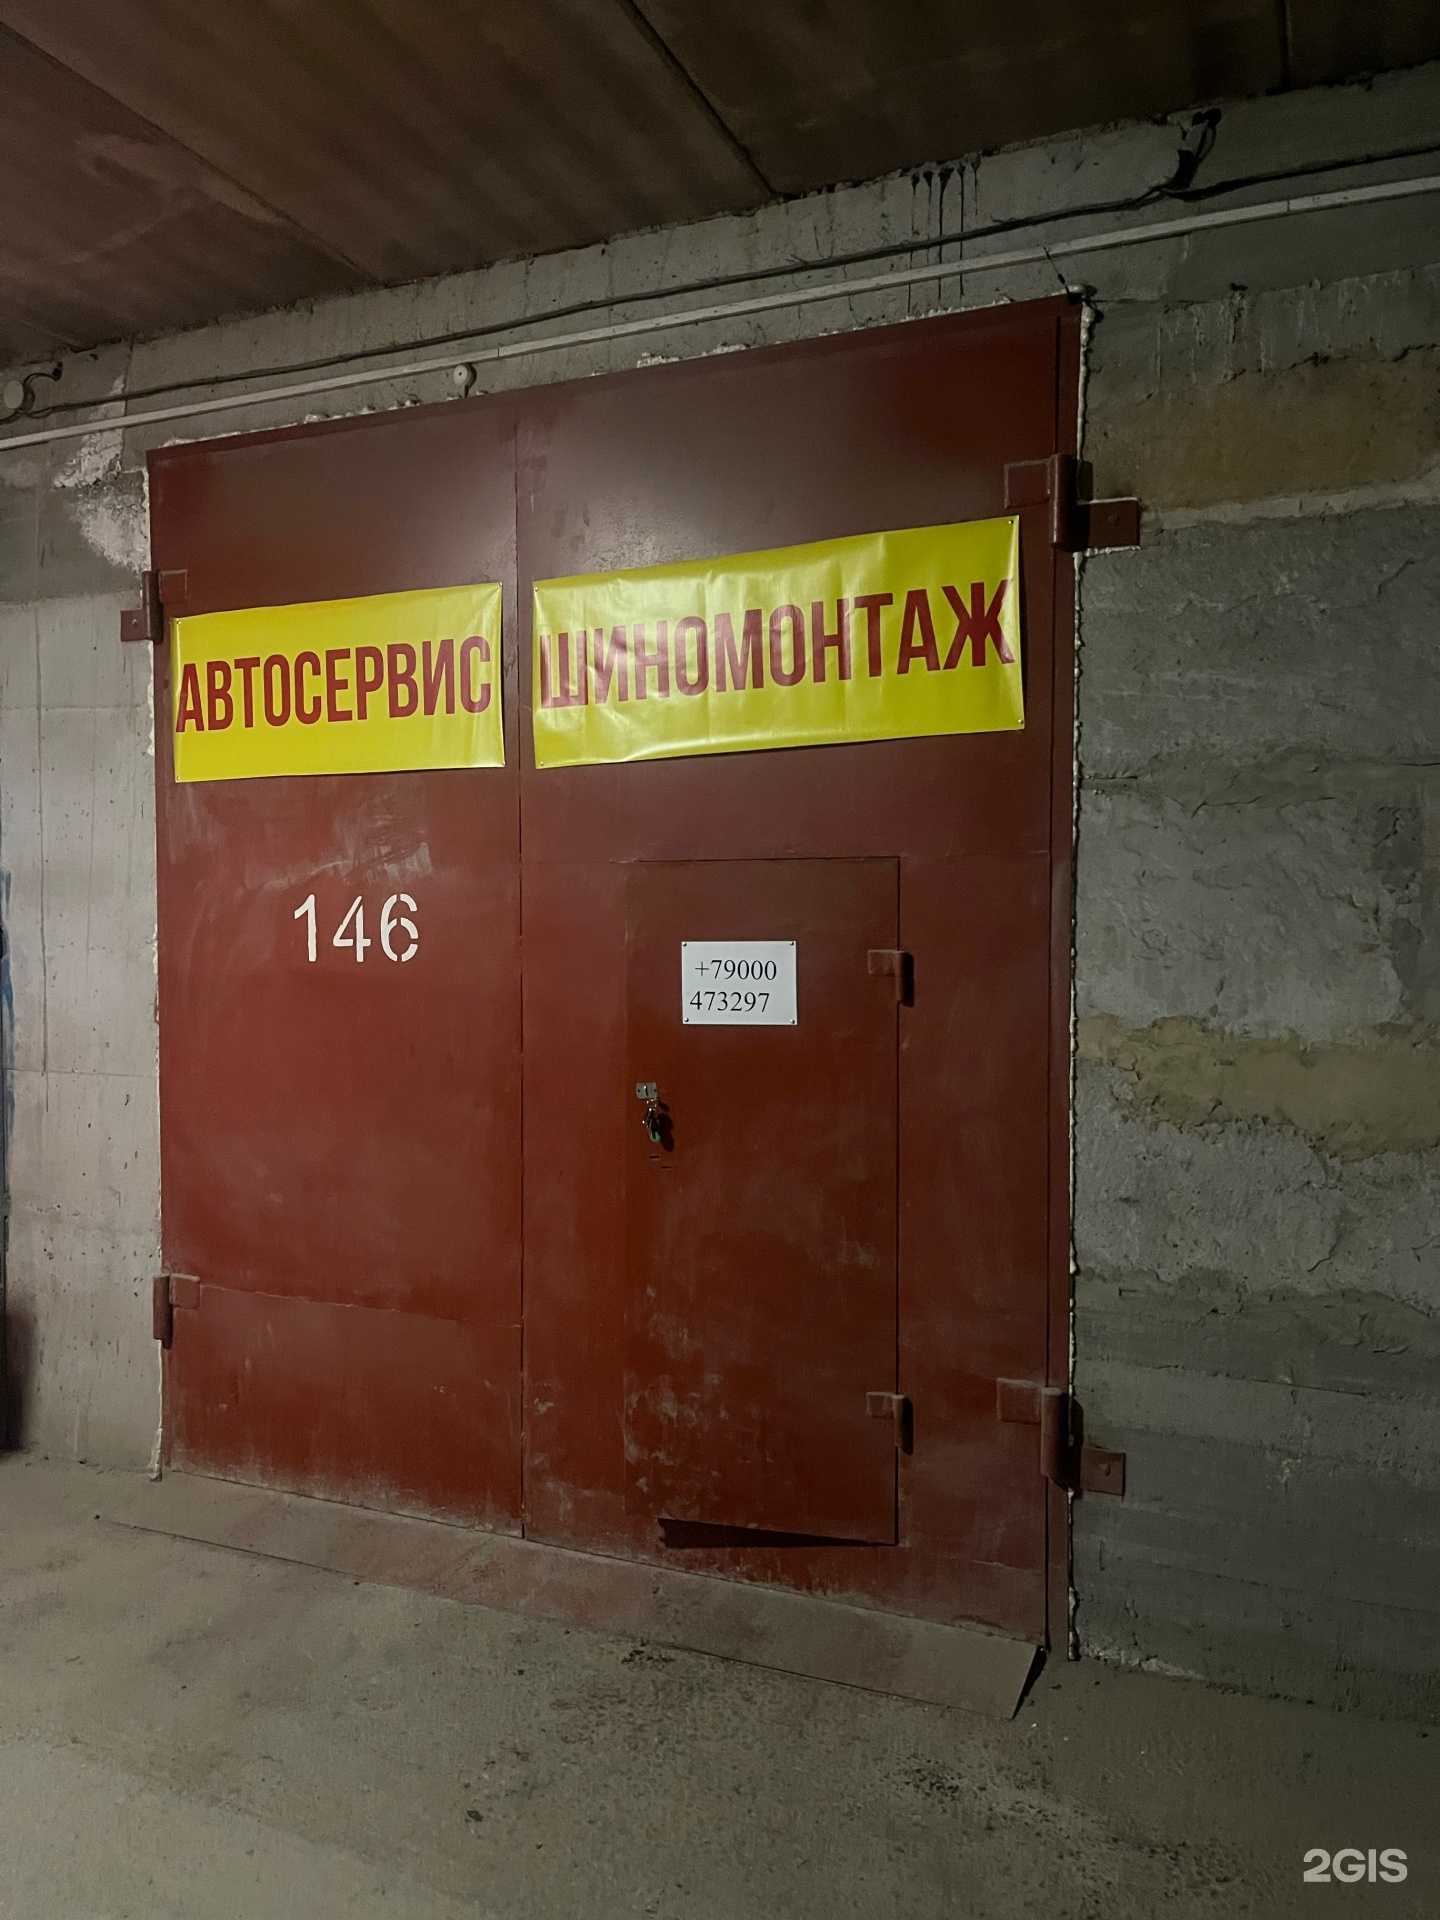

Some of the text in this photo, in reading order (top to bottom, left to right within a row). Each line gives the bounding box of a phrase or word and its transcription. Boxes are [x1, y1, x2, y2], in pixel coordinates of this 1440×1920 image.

[539, 578, 1016, 710] ШИНОМОНТАЖ
[175, 635, 493, 733] АВТОСЕРВИС
[293, 893, 419, 963] 146
[689, 990, 770, 1013] 473297
[695, 959, 777, 981] +79000
